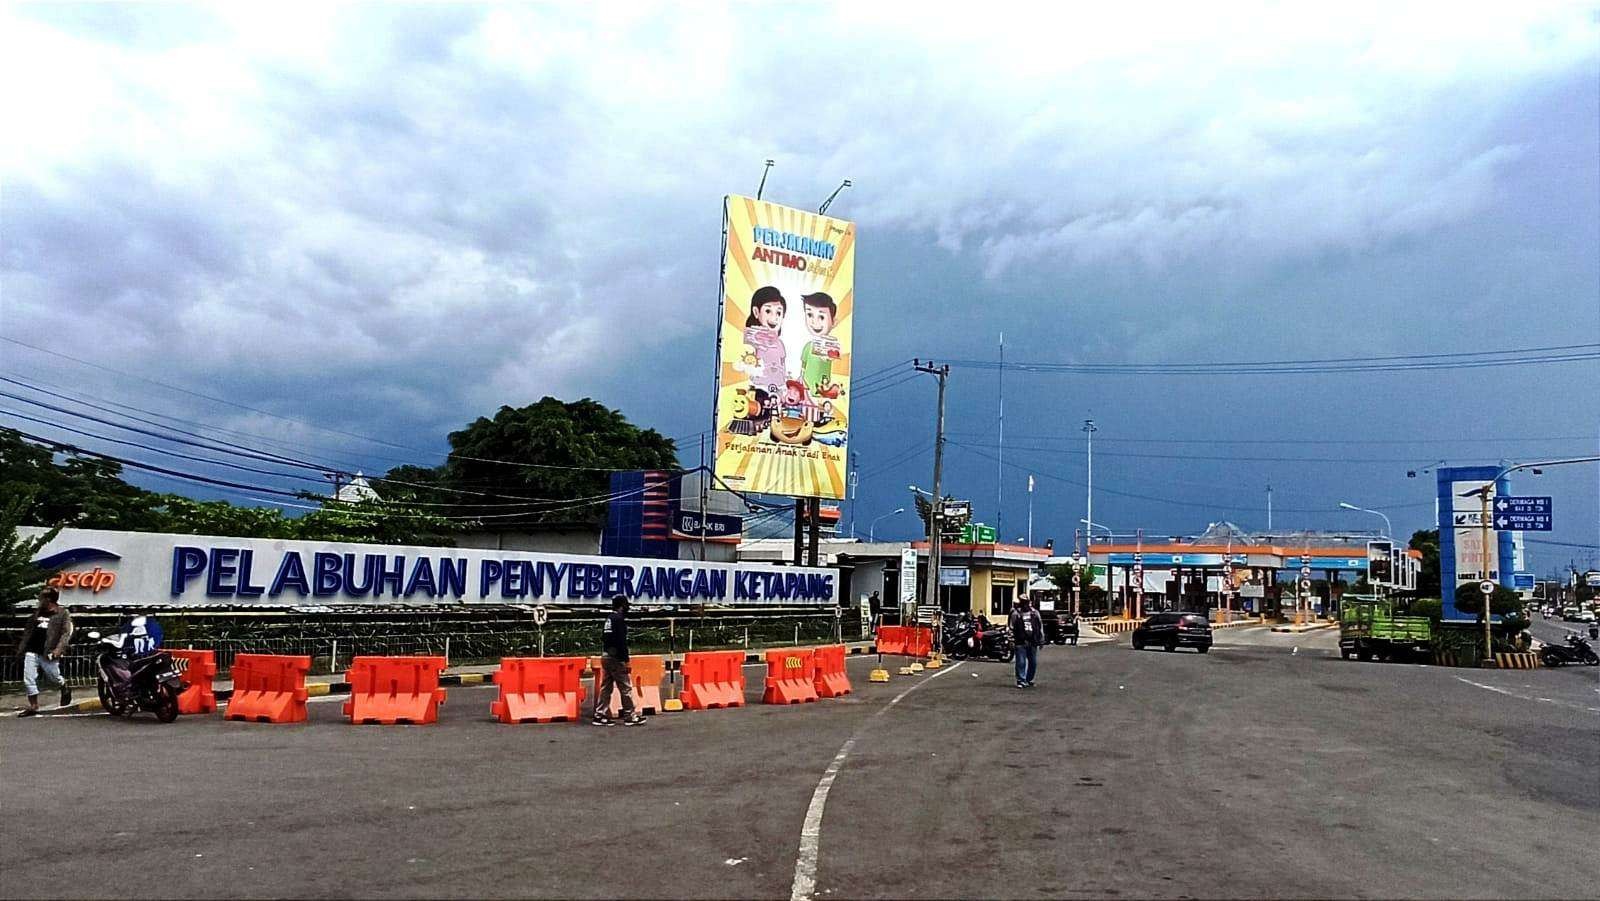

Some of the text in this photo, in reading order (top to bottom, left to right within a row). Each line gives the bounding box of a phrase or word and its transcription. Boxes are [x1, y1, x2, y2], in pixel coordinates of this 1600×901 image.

[753, 224, 836, 260] PERJALANAN
[752, 246, 807, 272] ANTIMO
[724, 442, 772, 454] Perjalanan
[774, 447, 798, 457] Anak
[800, 450, 819, 460] Jadi
[821, 452, 841, 462] Enak
[48, 568, 118, 593] asdp
[171, 546, 834, 601] PELABUHAN PENYEBERANGAN KETAPANG
